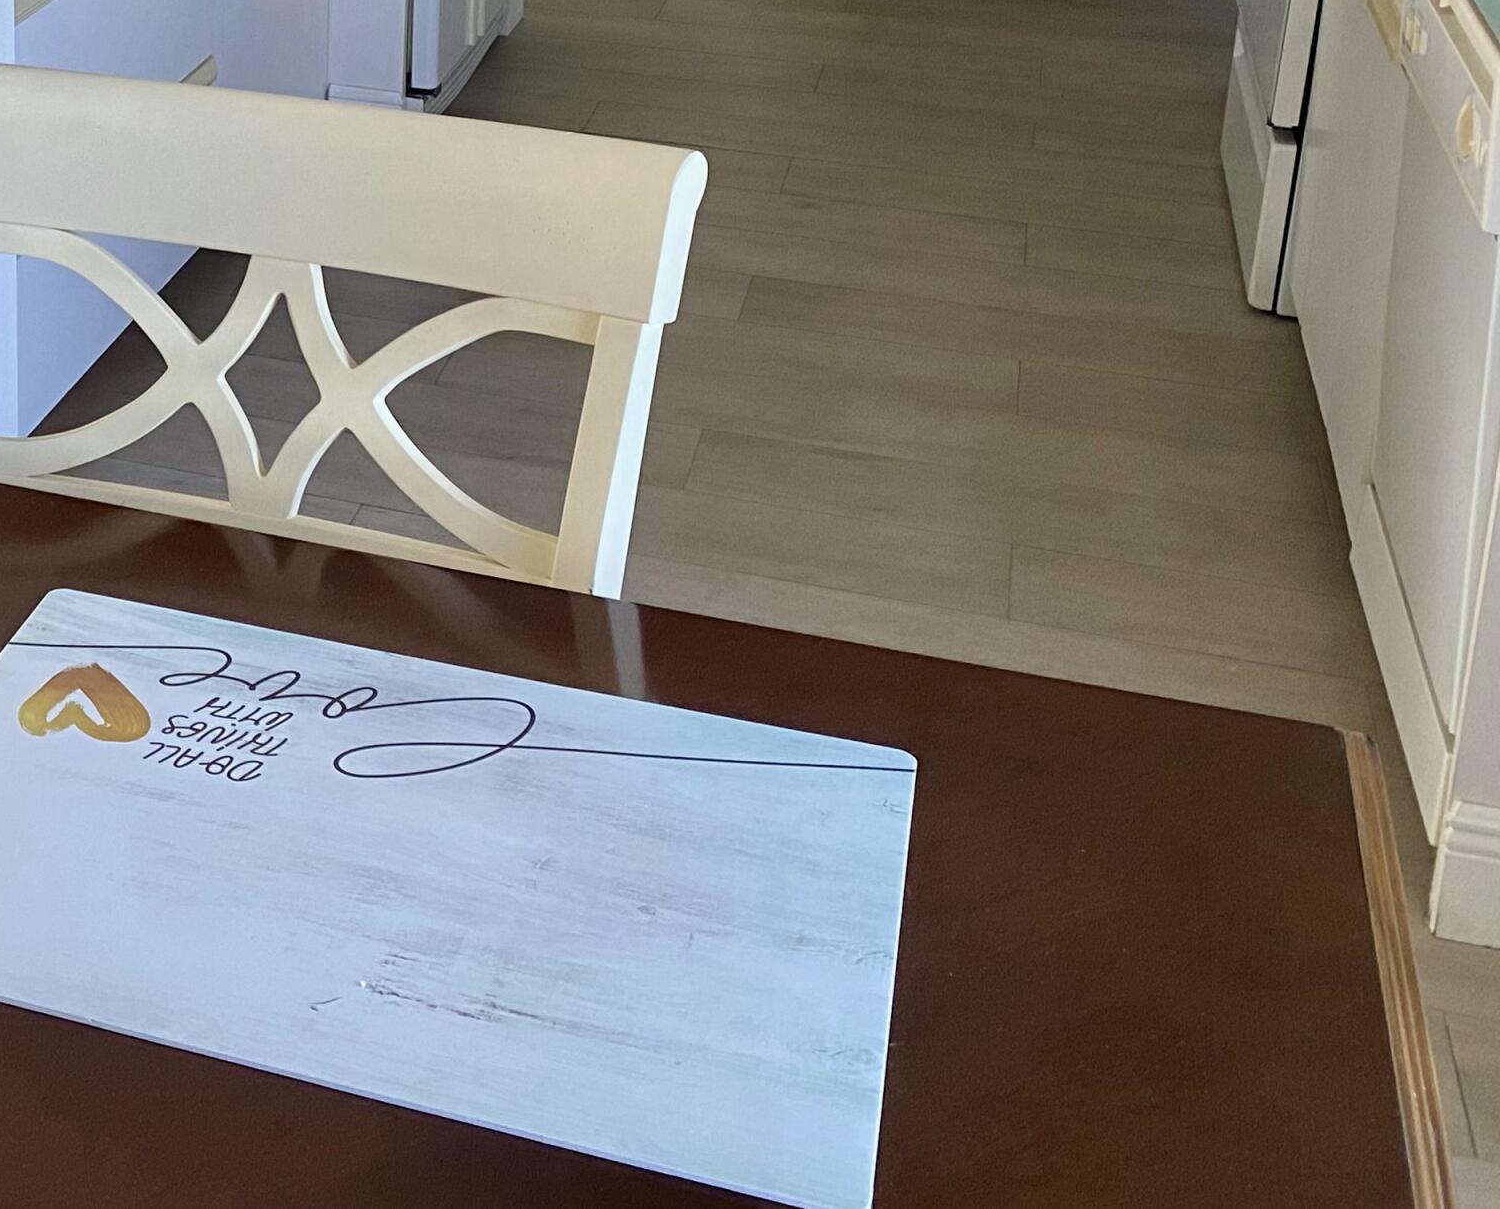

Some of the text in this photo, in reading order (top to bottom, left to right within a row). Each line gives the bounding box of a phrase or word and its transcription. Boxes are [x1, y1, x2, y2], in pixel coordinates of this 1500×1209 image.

[194, 696, 294, 731] WITH
[161, 714, 288, 758] THINGS
[143, 741, 263, 783] DO ALL
